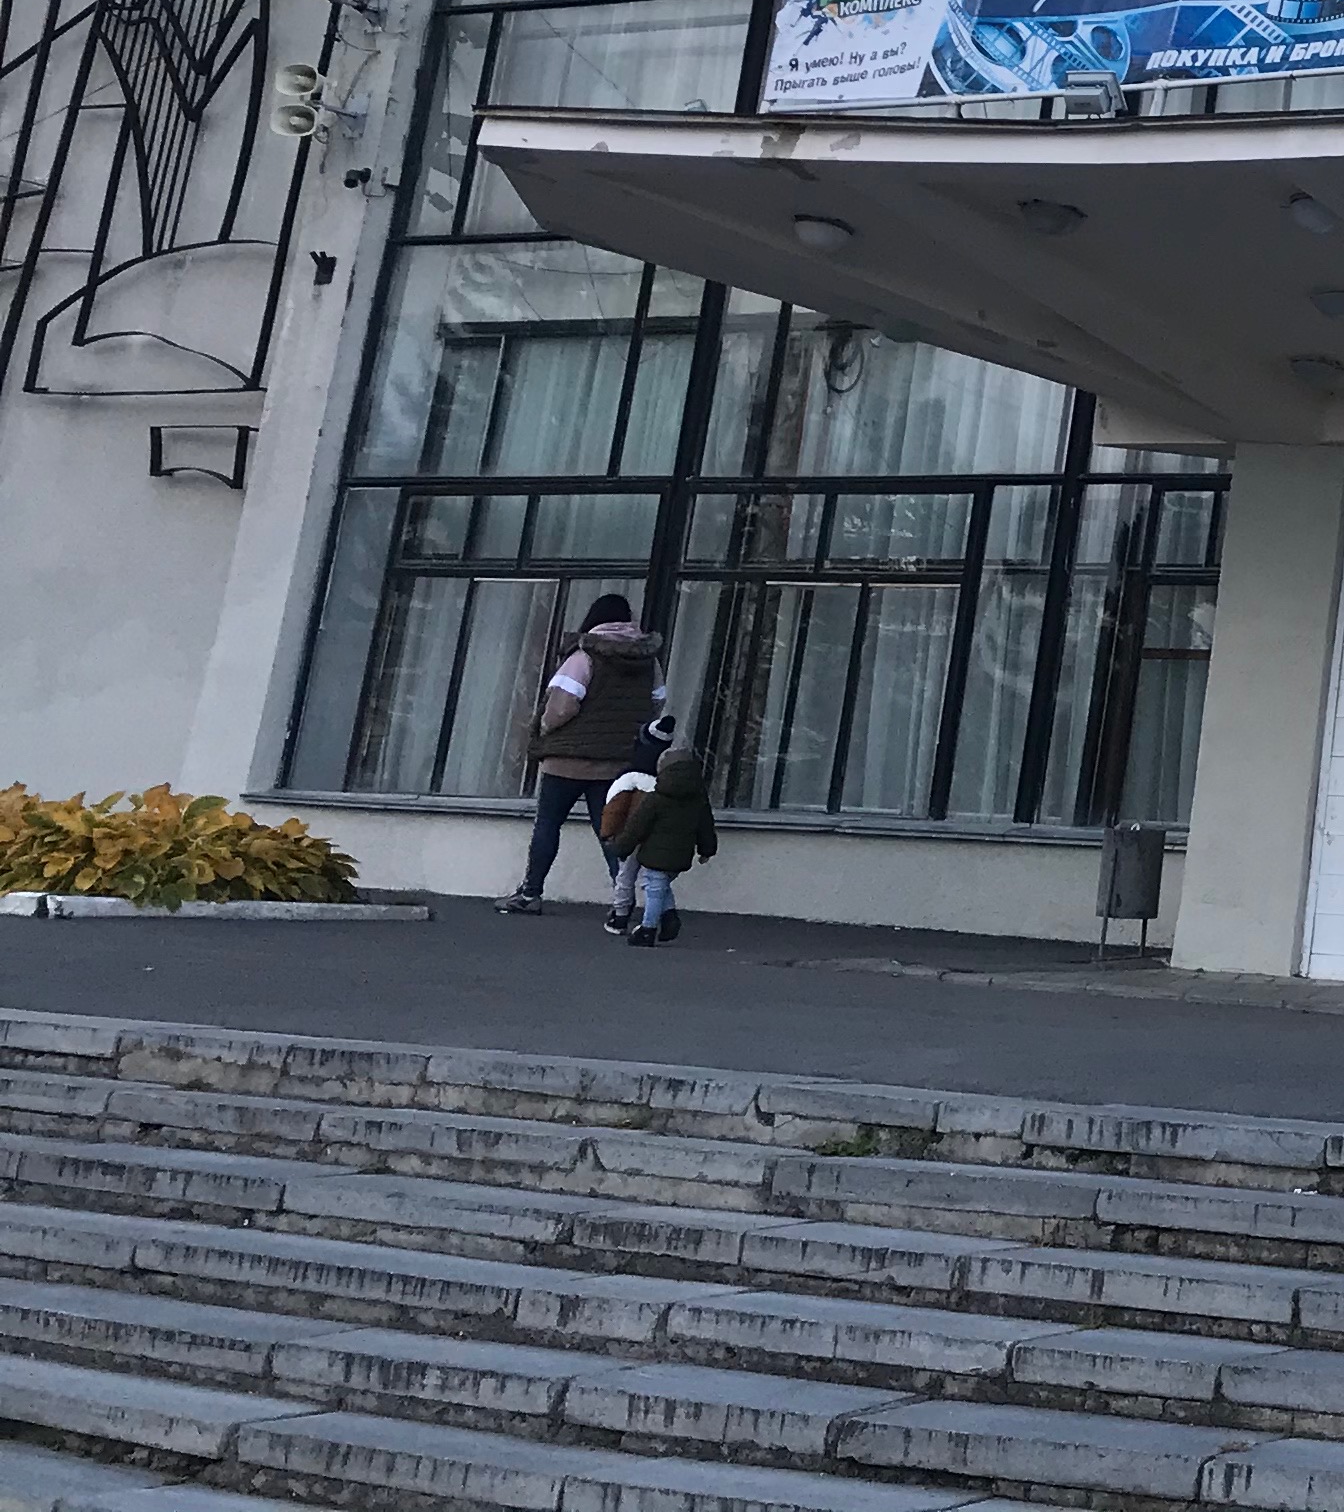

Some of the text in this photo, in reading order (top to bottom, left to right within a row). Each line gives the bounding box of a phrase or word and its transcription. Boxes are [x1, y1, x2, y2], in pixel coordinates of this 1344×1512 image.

[789, 58, 799, 71] Я
[805, 52, 844, 73] умею!
[850, 51, 865, 66] Ну
[870, 51, 877, 61] а
[882, 41, 907, 60] вы?
[1146, 45, 1262, 70] ПОКУПКА
[1265, 45, 1287, 64] И
[774, 56, 921, 93] Прыгать выше головы!
